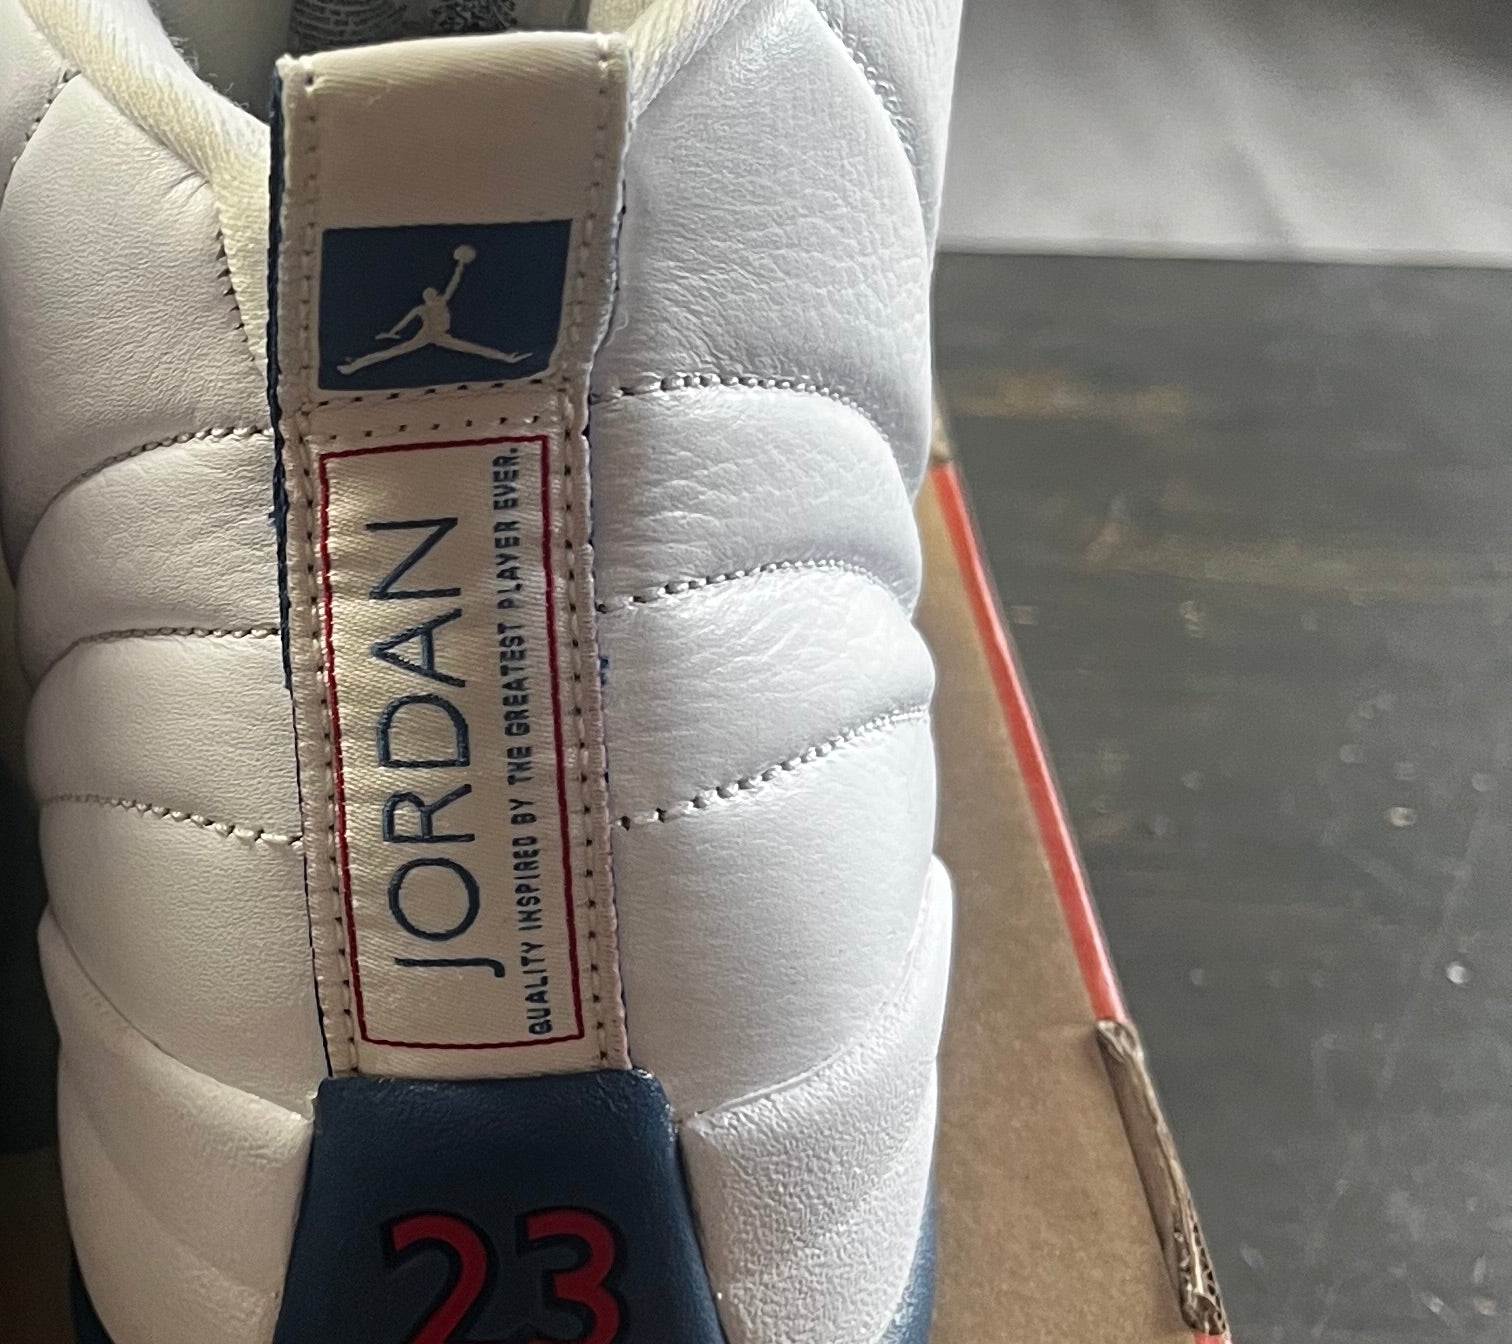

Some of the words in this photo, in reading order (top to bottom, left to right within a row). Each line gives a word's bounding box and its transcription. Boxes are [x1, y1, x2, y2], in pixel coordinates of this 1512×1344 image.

[492, 447, 520, 510] EVER.
[494, 521, 523, 609] PLAYER
[497, 622, 531, 737] GREATEST
[365, 517, 505, 978] JORDAN
[506, 746, 534, 785] THE
[510, 798, 537, 825] BY
[512, 835, 542, 931] INSPIRED
[520, 942, 553, 1035] QUALITY
